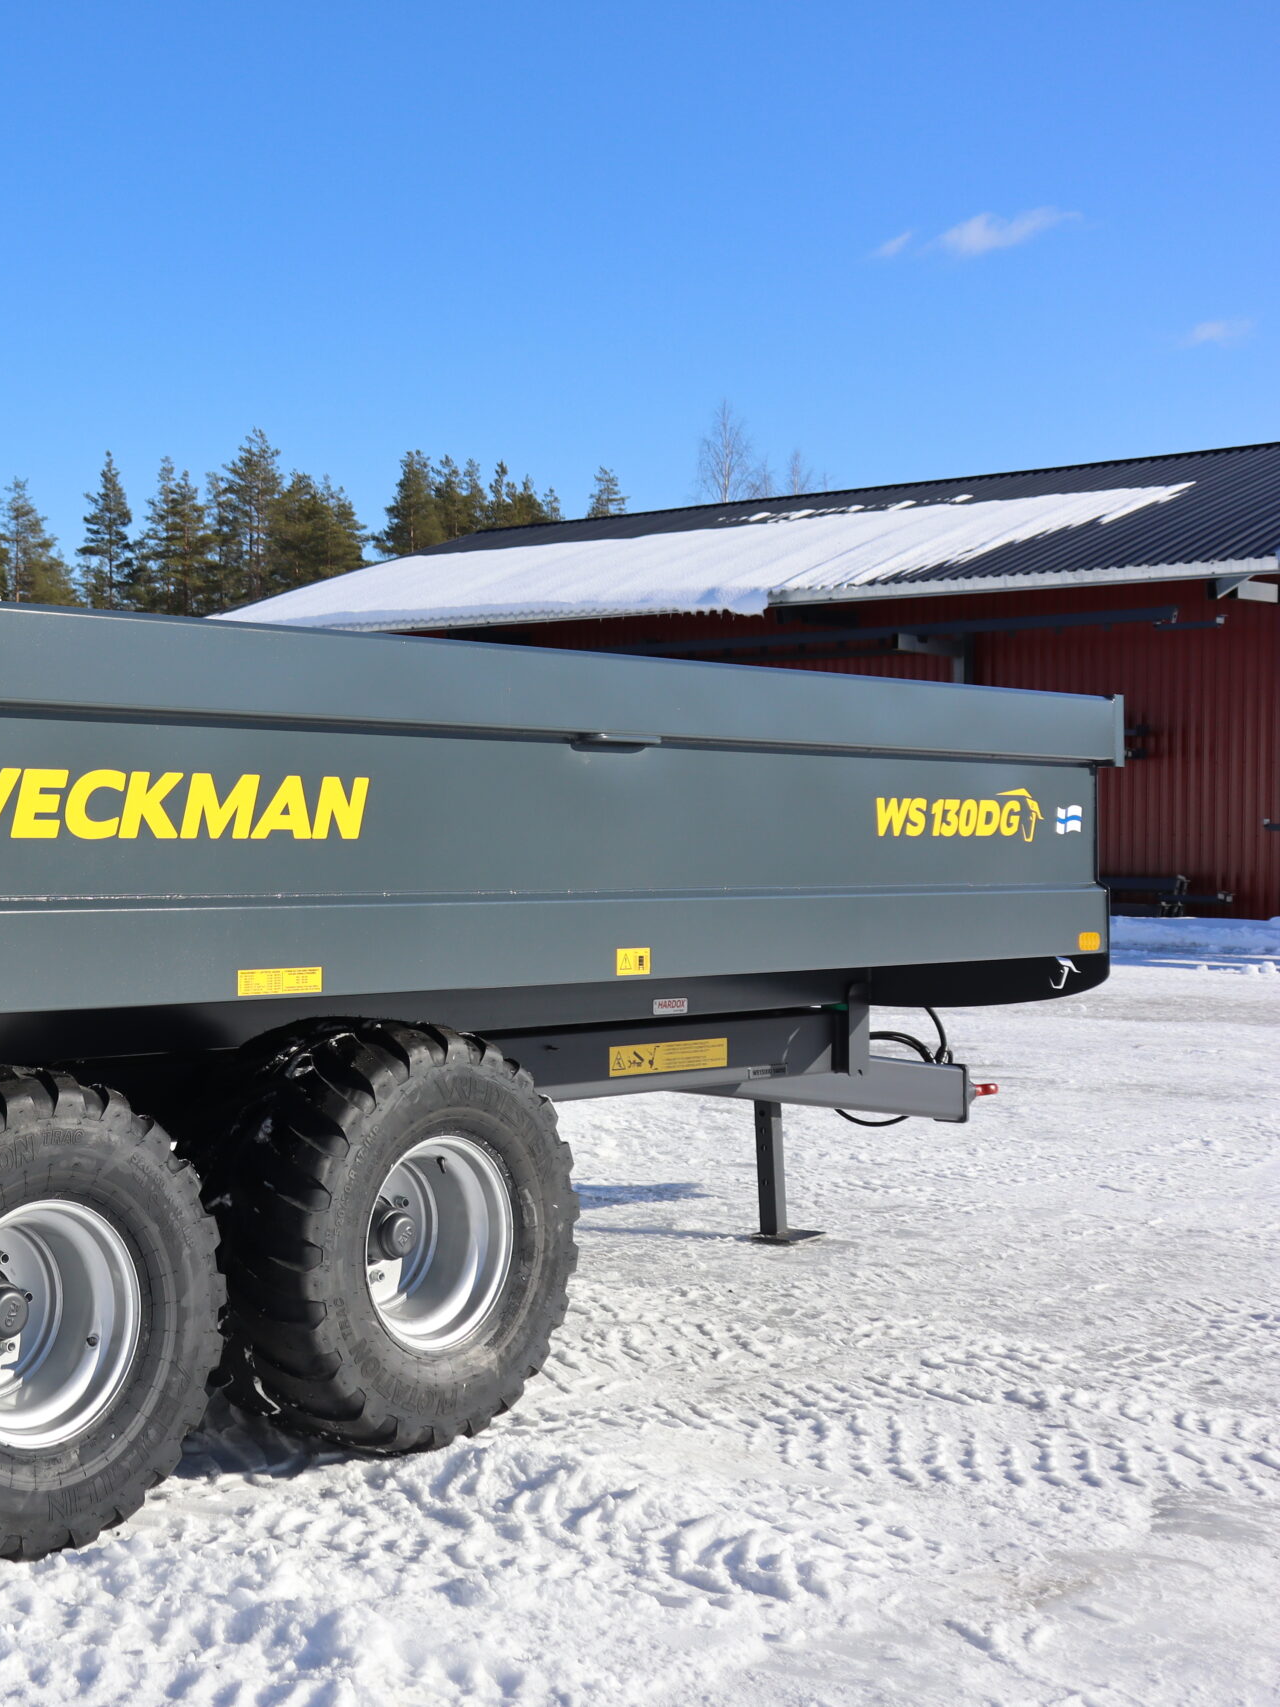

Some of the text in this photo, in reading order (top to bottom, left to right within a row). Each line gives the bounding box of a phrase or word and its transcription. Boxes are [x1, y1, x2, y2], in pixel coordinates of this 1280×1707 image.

[876, 797, 1021, 837] WS 130DG
[657, 999, 686, 1009] HARDOX
[42, 1127, 85, 1146] TRAC
